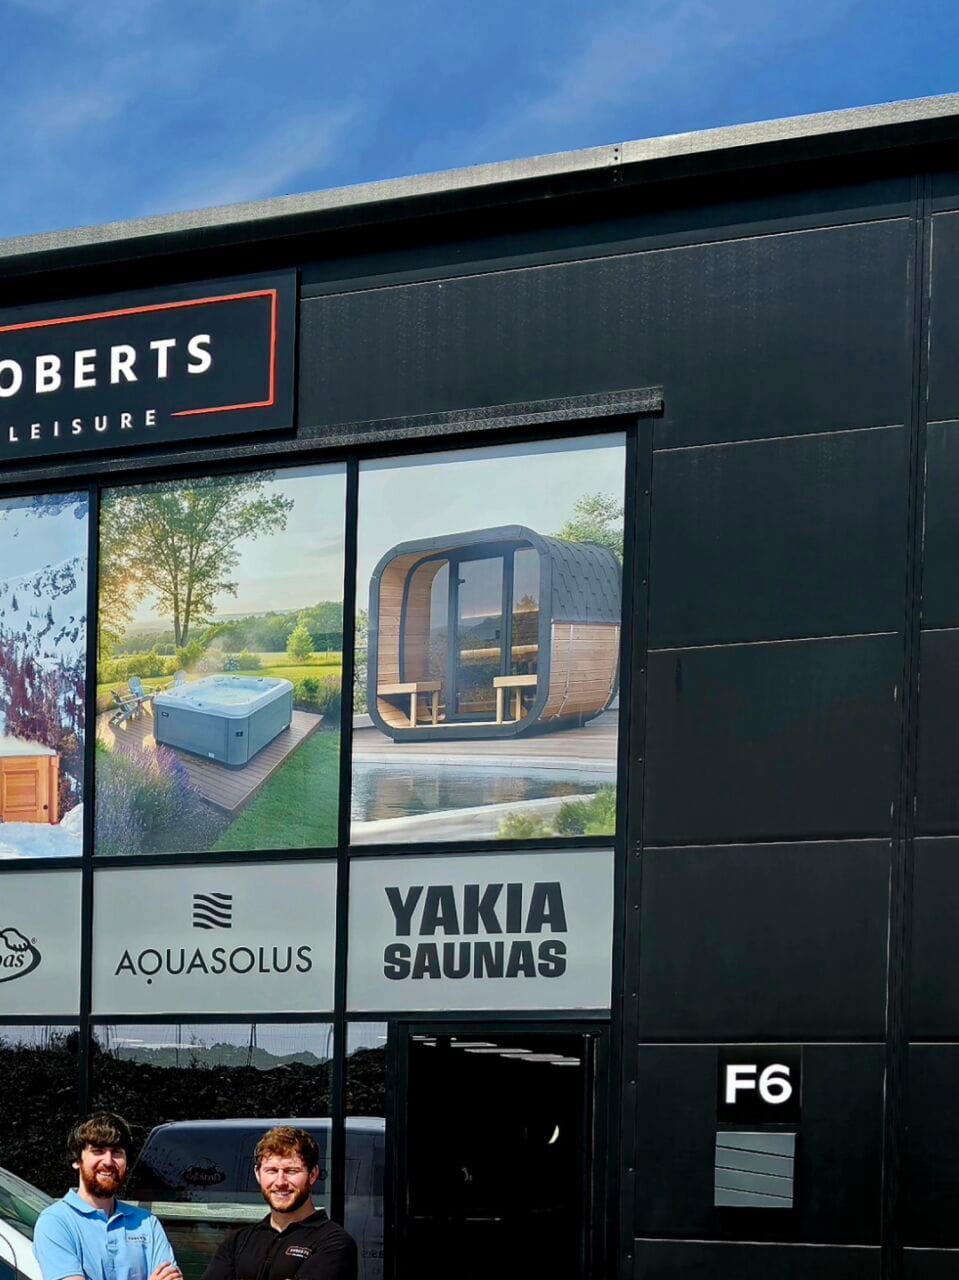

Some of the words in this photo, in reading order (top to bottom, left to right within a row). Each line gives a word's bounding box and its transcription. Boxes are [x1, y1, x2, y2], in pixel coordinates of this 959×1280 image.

[9, 409, 156, 442] LEISURE
[384, 881, 567, 936] YAKIA
[114, 945, 313, 984] AQUASOLUS
[383, 939, 567, 981] SAUNAS
[725, 1063, 792, 1104] F6
